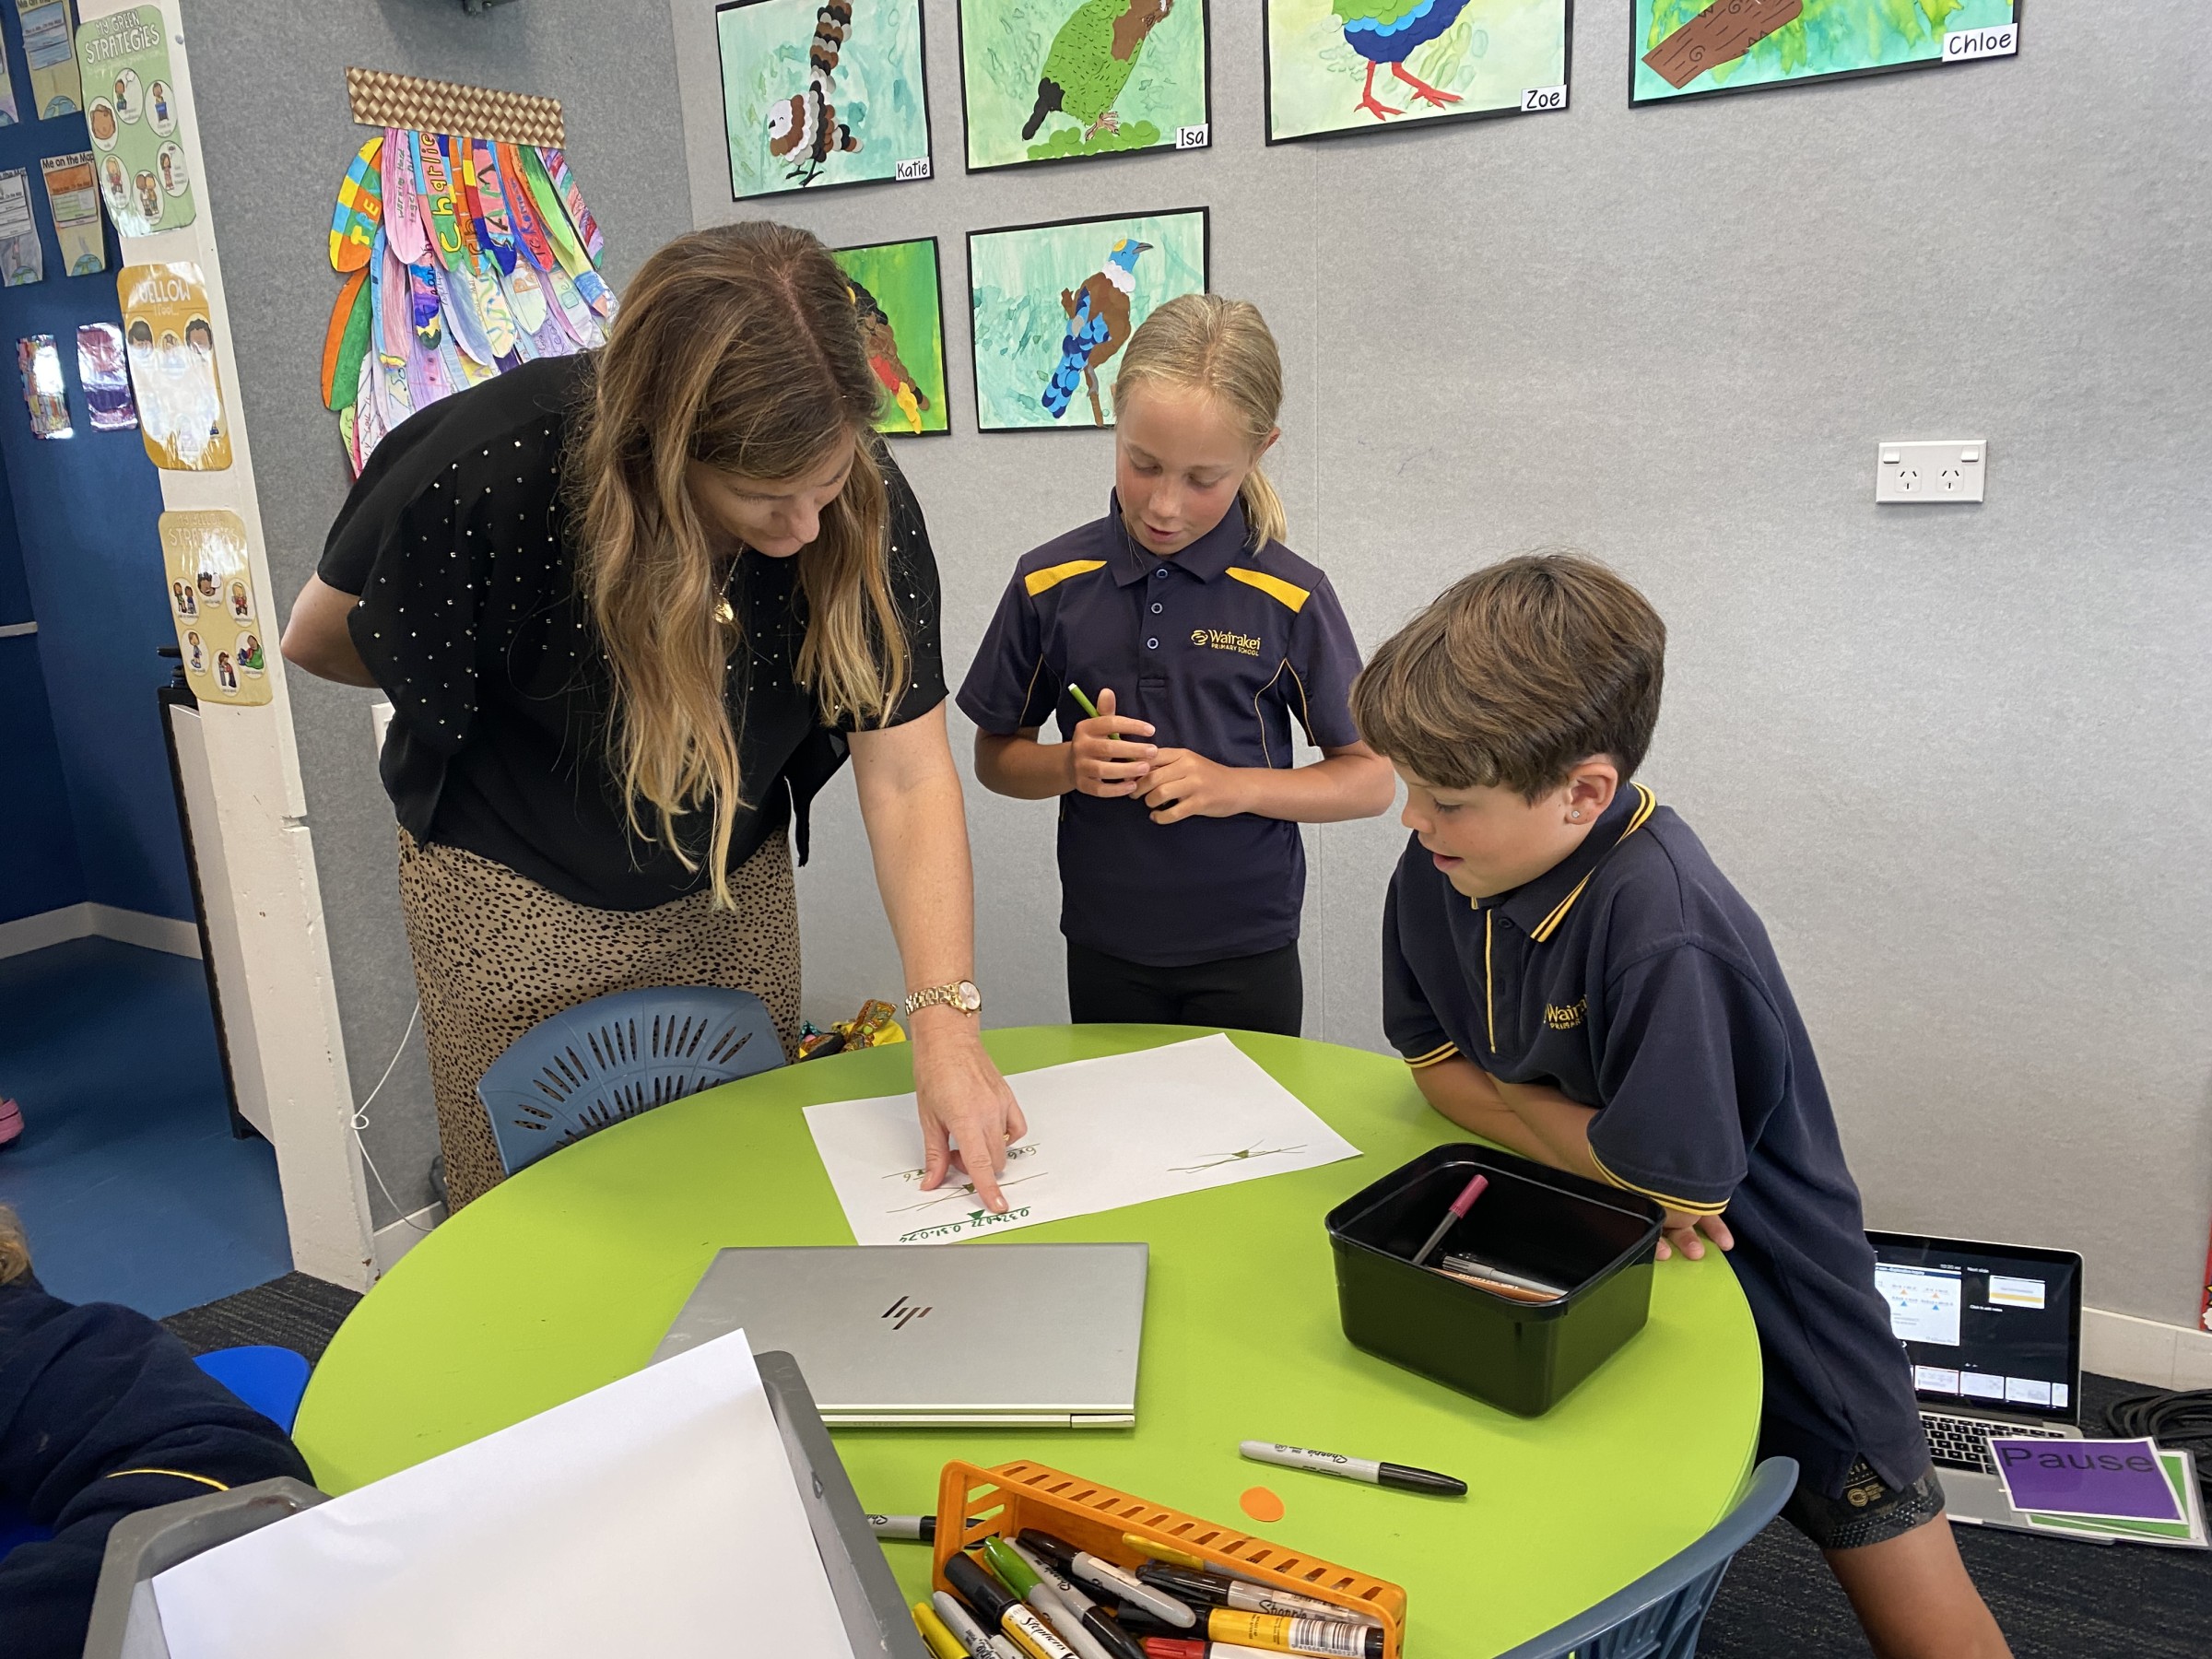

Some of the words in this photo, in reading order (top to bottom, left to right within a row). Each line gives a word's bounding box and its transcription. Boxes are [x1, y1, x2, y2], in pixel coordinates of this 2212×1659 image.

[111, 10, 140, 31] GREEN
[1949, 32, 2011, 54] Chloe
[1526, 89, 1560, 109] Zoe
[1180, 128, 1204, 146] Isa
[42, 159, 53, 169] Me
[66, 156, 78, 165] the
[897, 160, 928, 178] Katie
[420, 134, 462, 253] Charlie
[1207, 629, 1261, 650] Wairakei
[2001, 1447, 2155, 1473] Pause
[1020, 1617, 1065, 1650] Stephens
